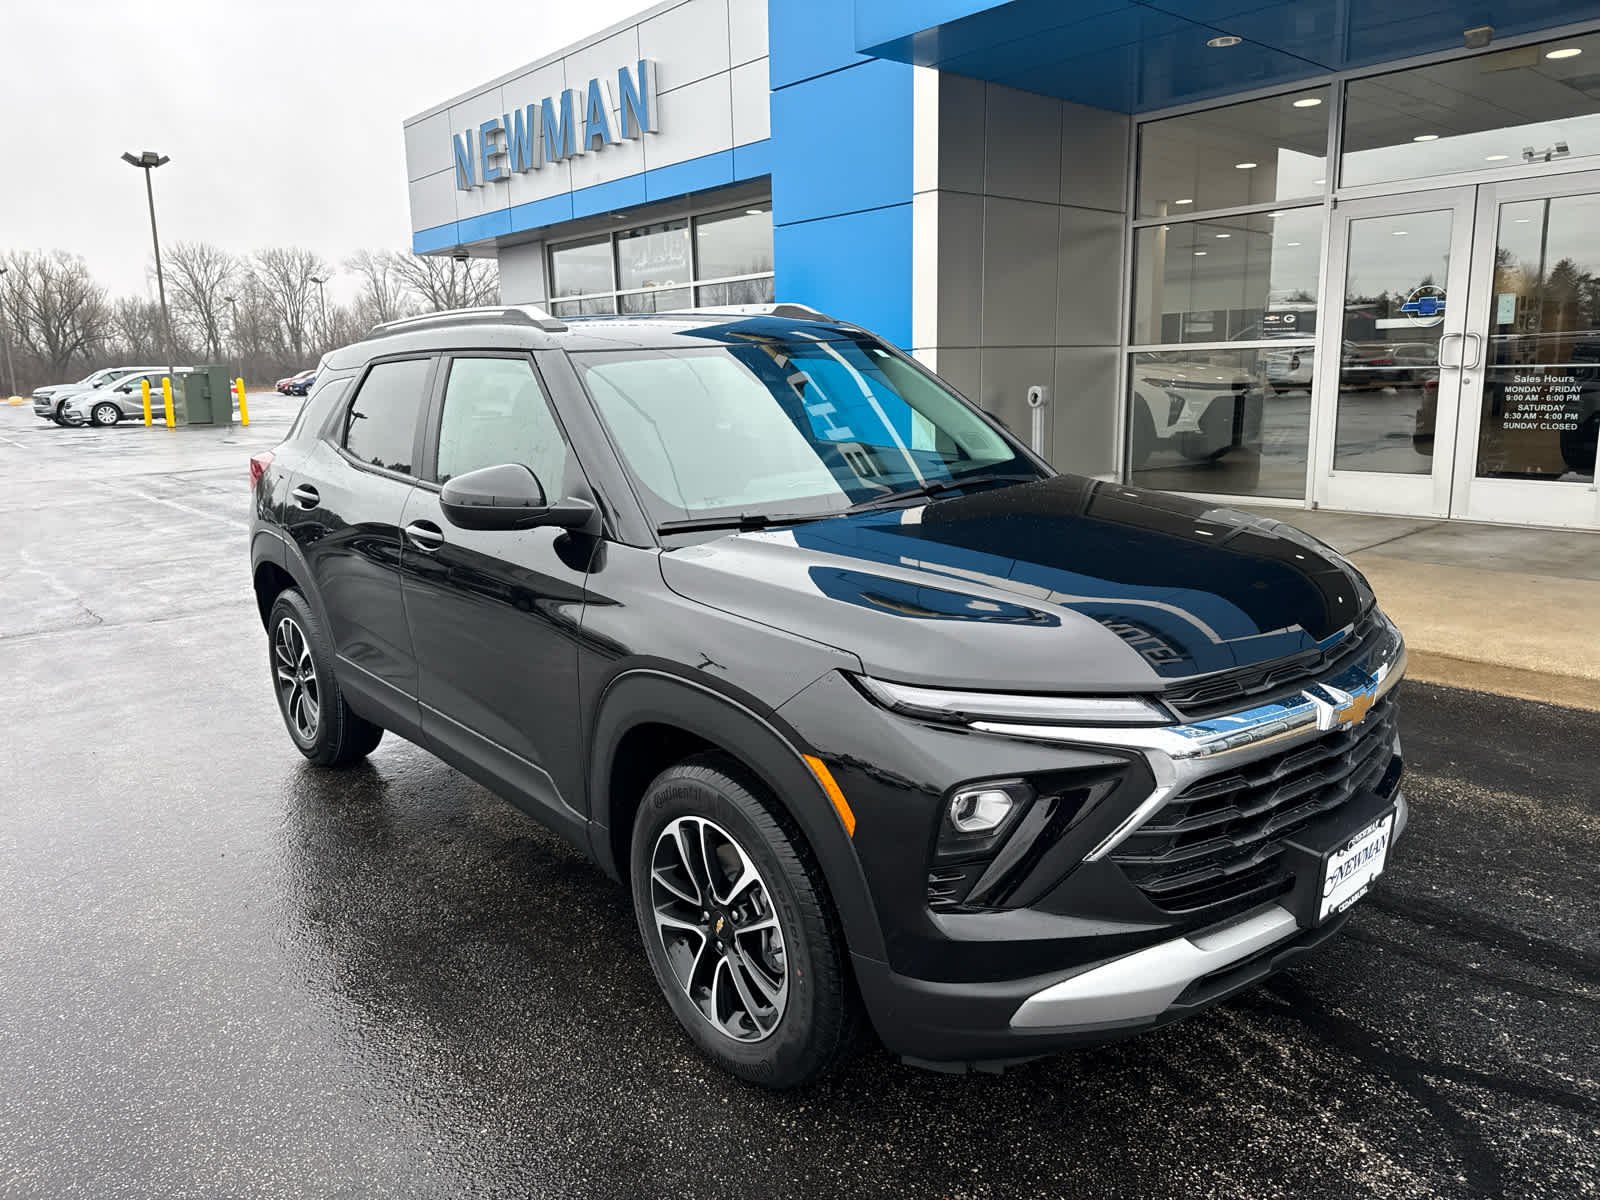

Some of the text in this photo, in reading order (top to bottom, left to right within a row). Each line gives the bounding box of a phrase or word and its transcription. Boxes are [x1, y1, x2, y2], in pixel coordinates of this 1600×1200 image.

[453, 59, 657, 191] NEWMAN
[1514, 375, 1575, 383] Sales Hours
[1327, 832, 1388, 886] NEWMAN
